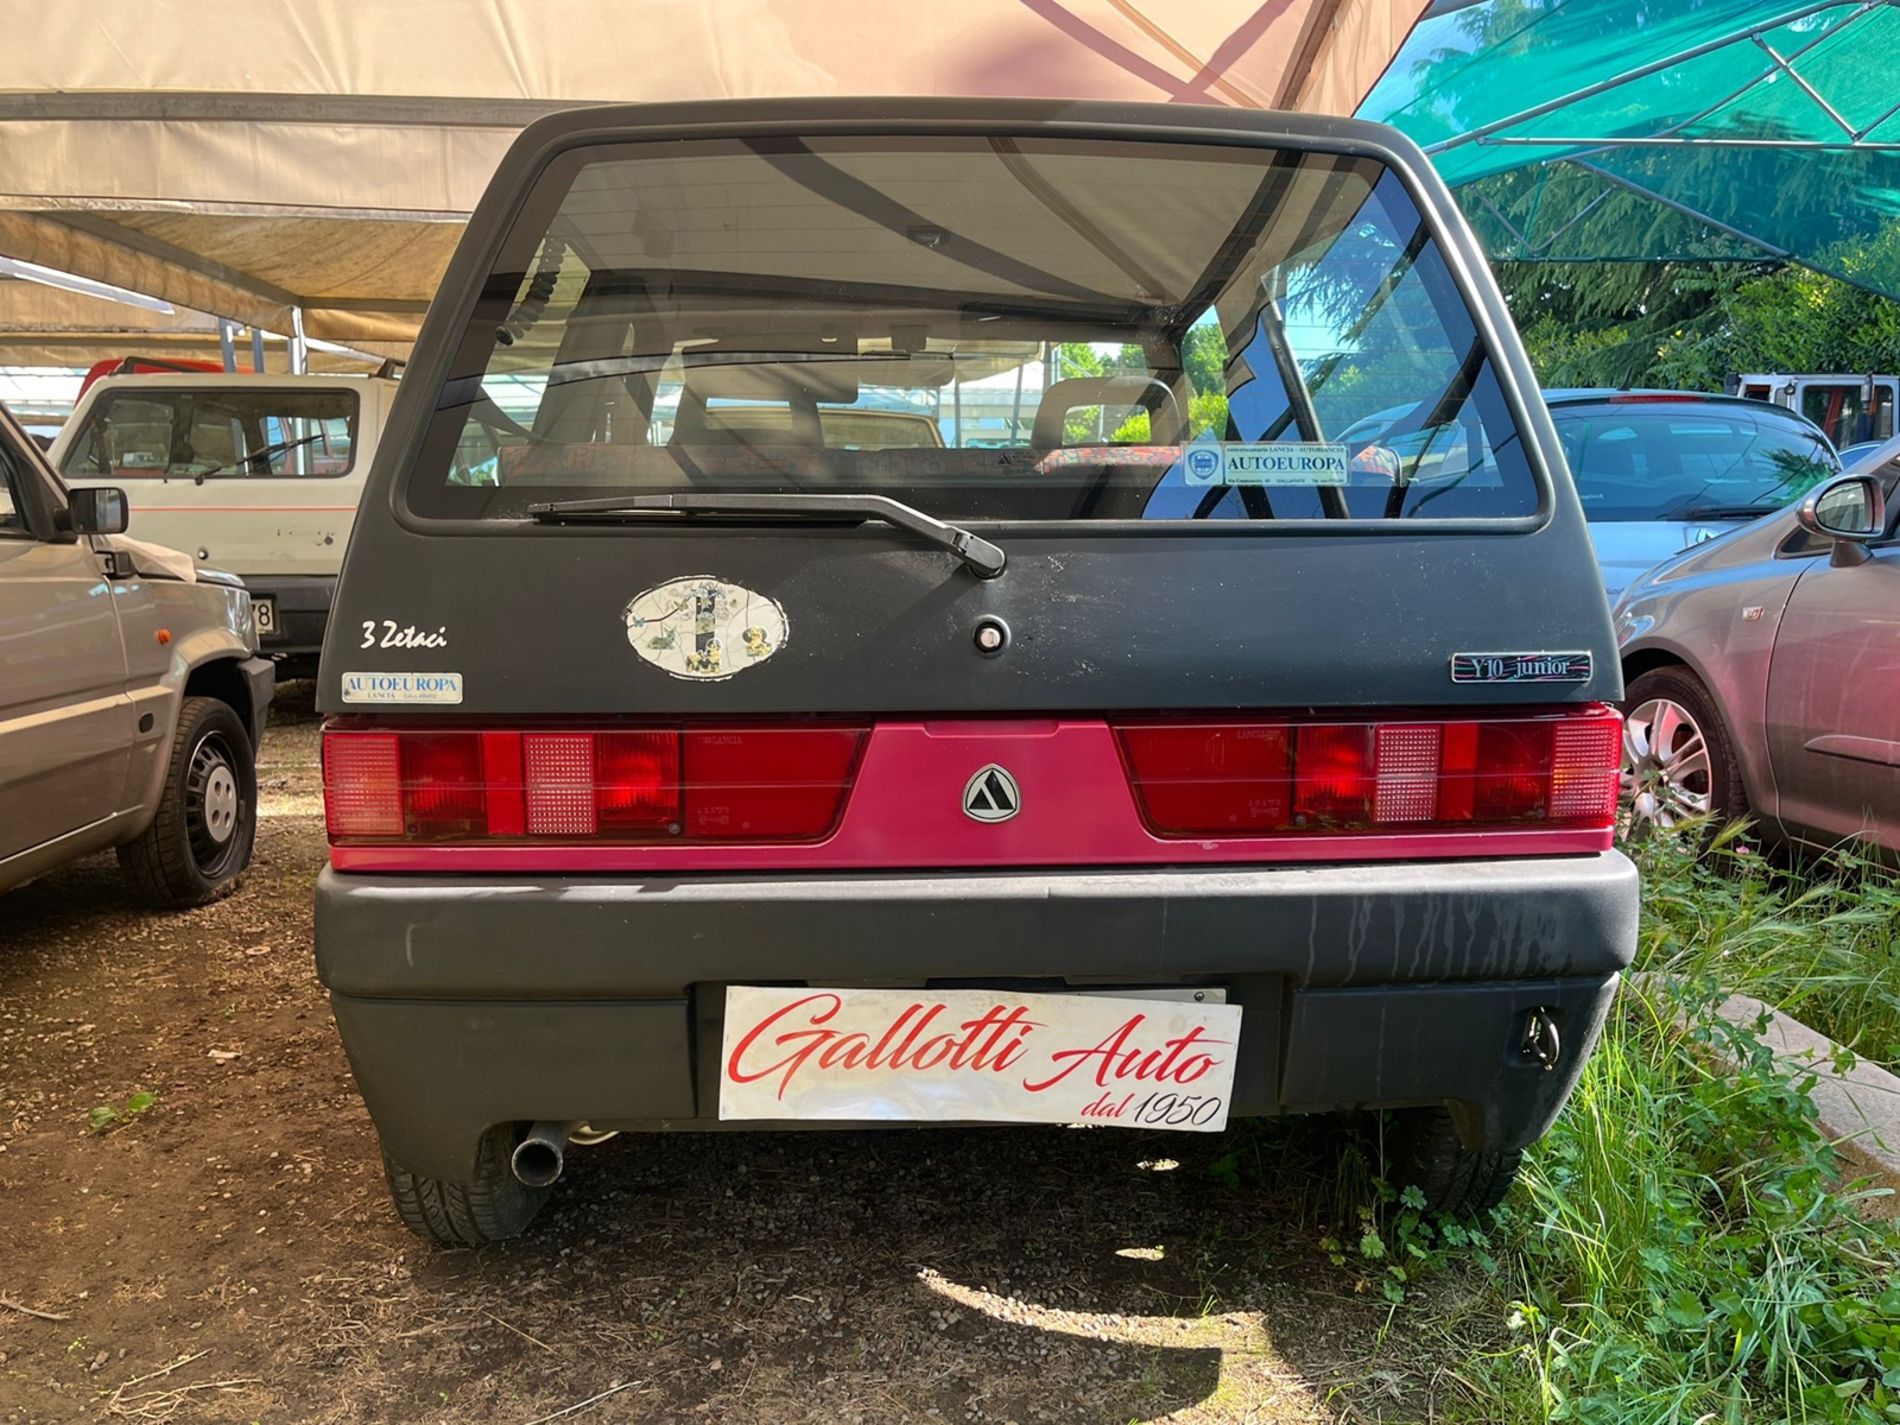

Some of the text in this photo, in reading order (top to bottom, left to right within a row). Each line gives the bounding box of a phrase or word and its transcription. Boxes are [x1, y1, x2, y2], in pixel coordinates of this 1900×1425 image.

[1228, 456, 1344, 470] AUTOEUROPA
[252, 603, 271, 627] 8
[360, 620, 448, 649] 3 Zetaci
[1471, 657, 1570, 678] Y10 junior
[349, 677, 457, 692] AUTOEUROPA
[727, 993, 1234, 1102] Gallotti Auto
[1079, 1091, 1223, 1127] dal 1950
